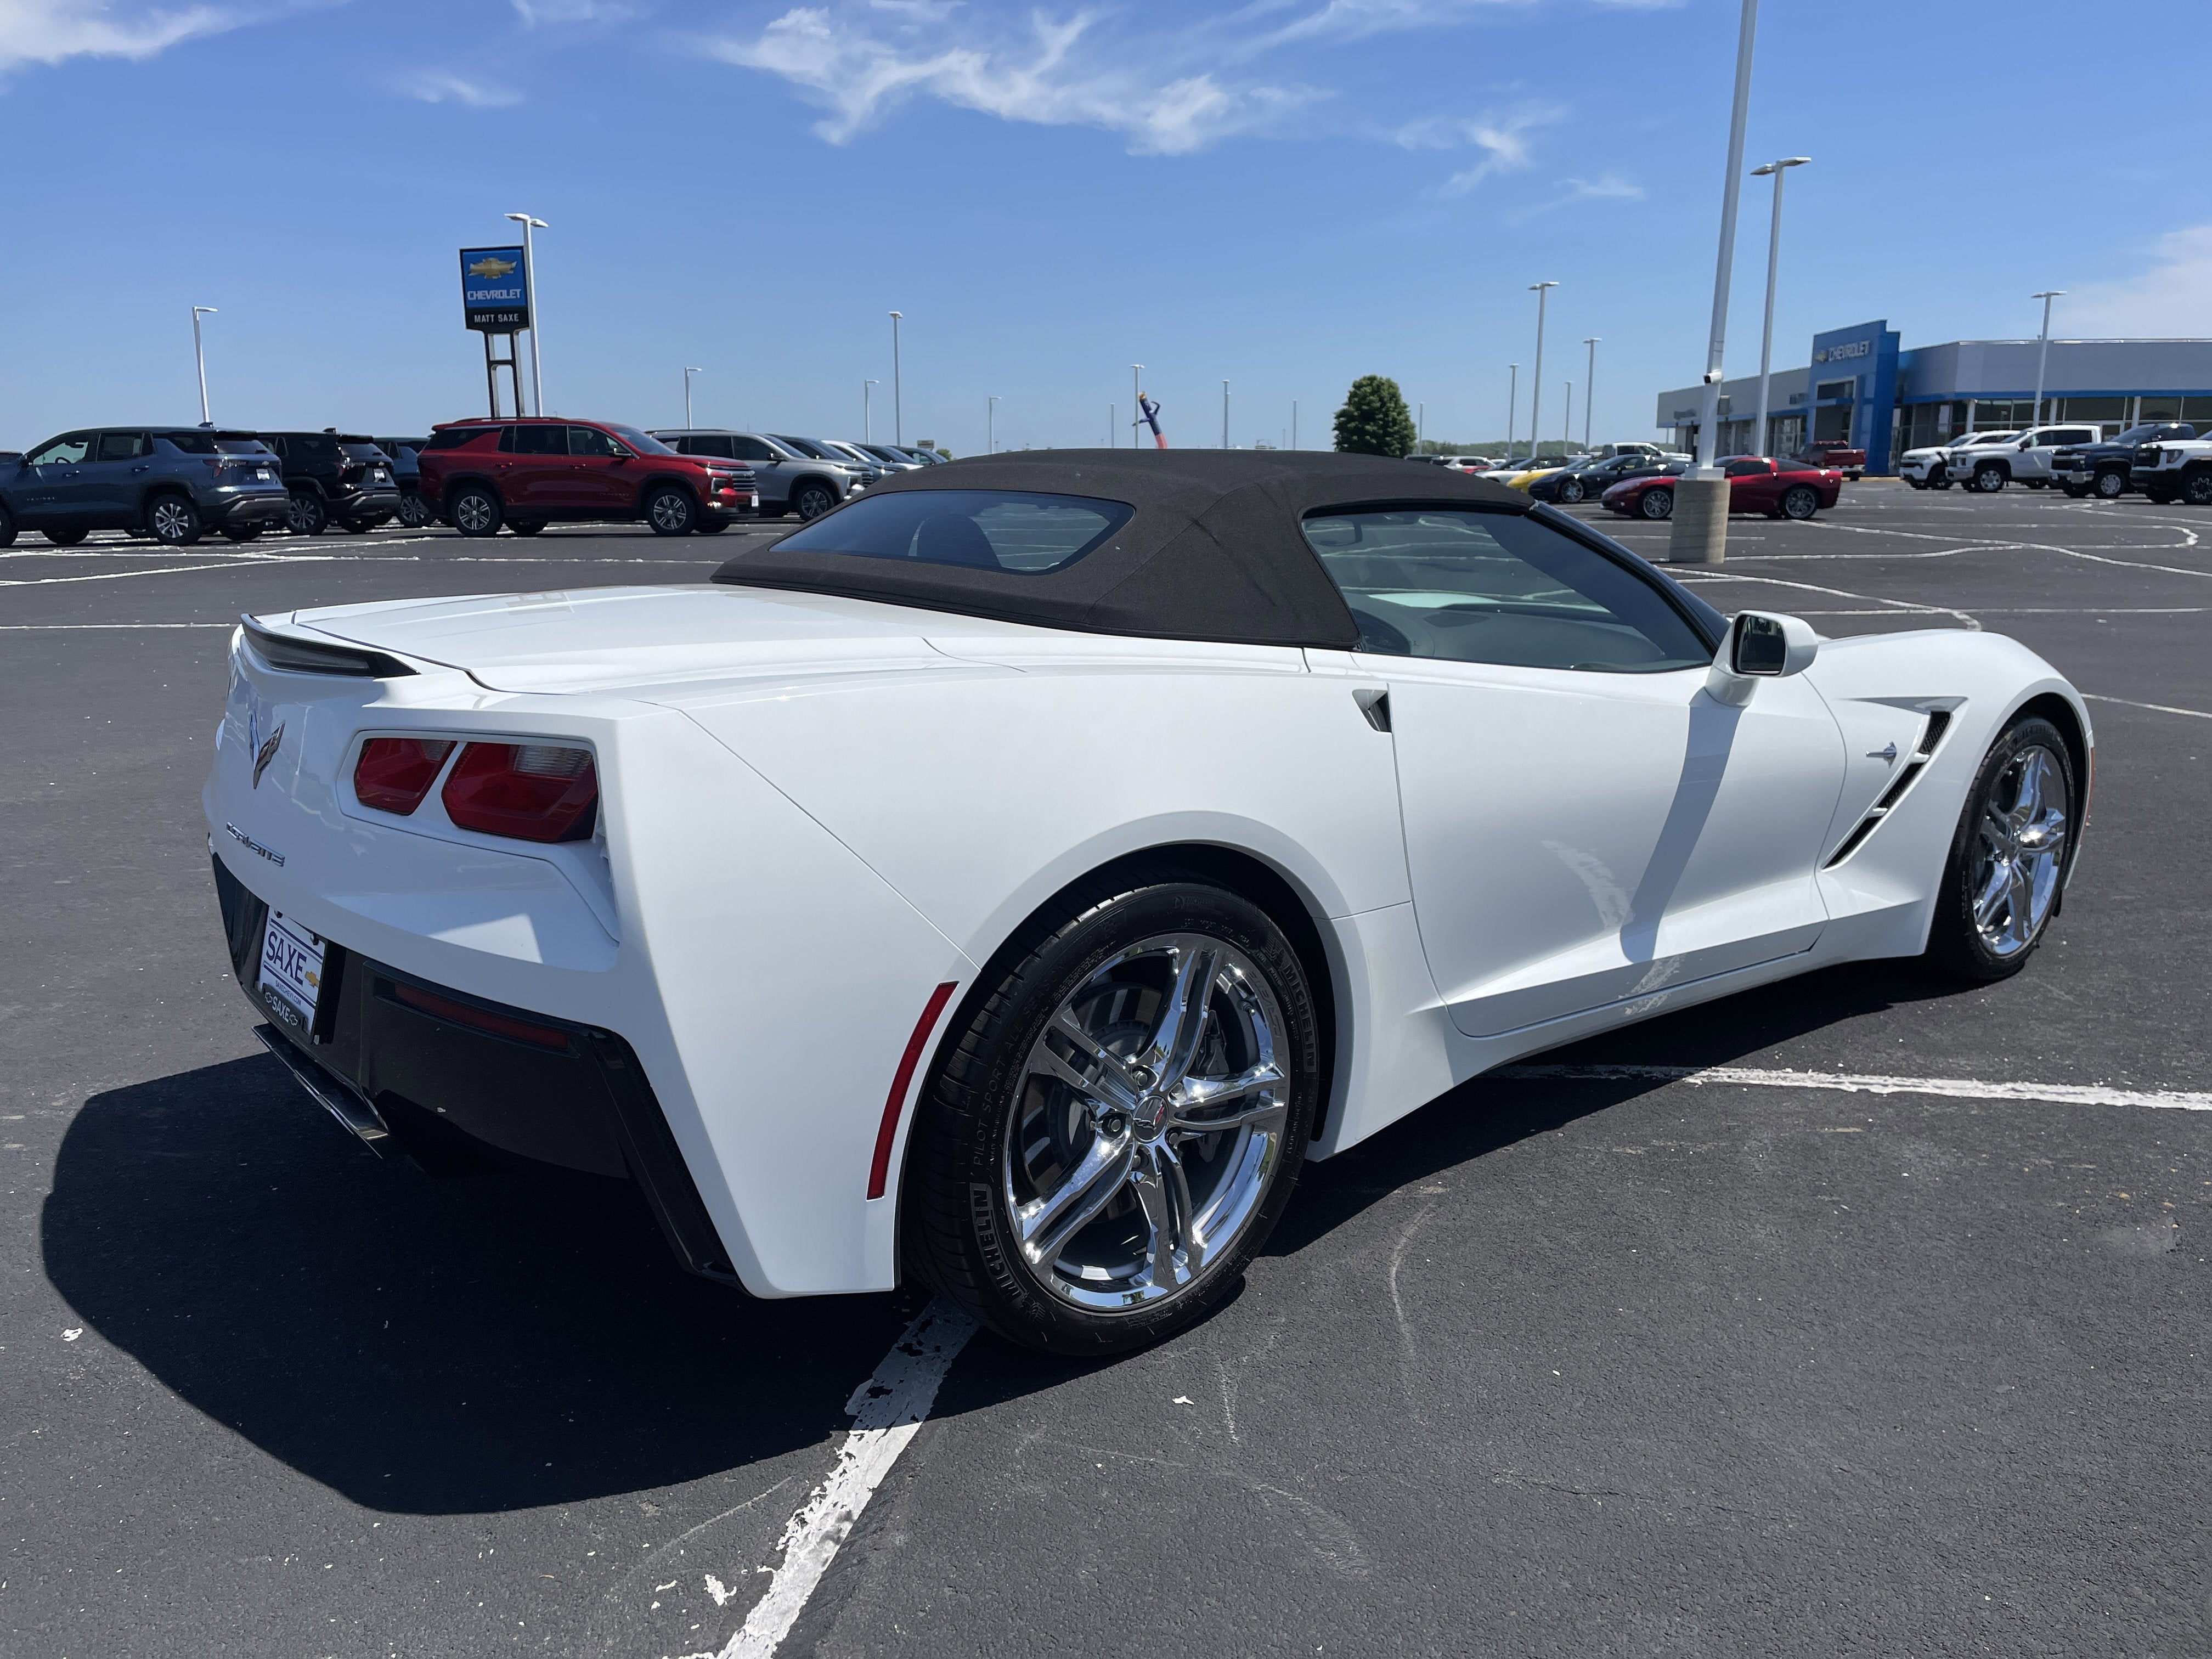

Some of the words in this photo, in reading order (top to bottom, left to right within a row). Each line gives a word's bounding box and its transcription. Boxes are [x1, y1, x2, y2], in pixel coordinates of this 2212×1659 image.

[467, 289, 521, 301] CHEVROLET
[474, 314, 495, 323] MATT
[498, 313, 519, 323] SAXE
[266, 931, 307, 987] SAXE
[272, 996, 290, 1023] SAXE
[1283, 963, 1316, 1066] MICHELIN
[973, 1118, 988, 1166] PILOT
[983, 1056, 1005, 1113] SPORT
[973, 1188, 1020, 1301] MICHELIN
